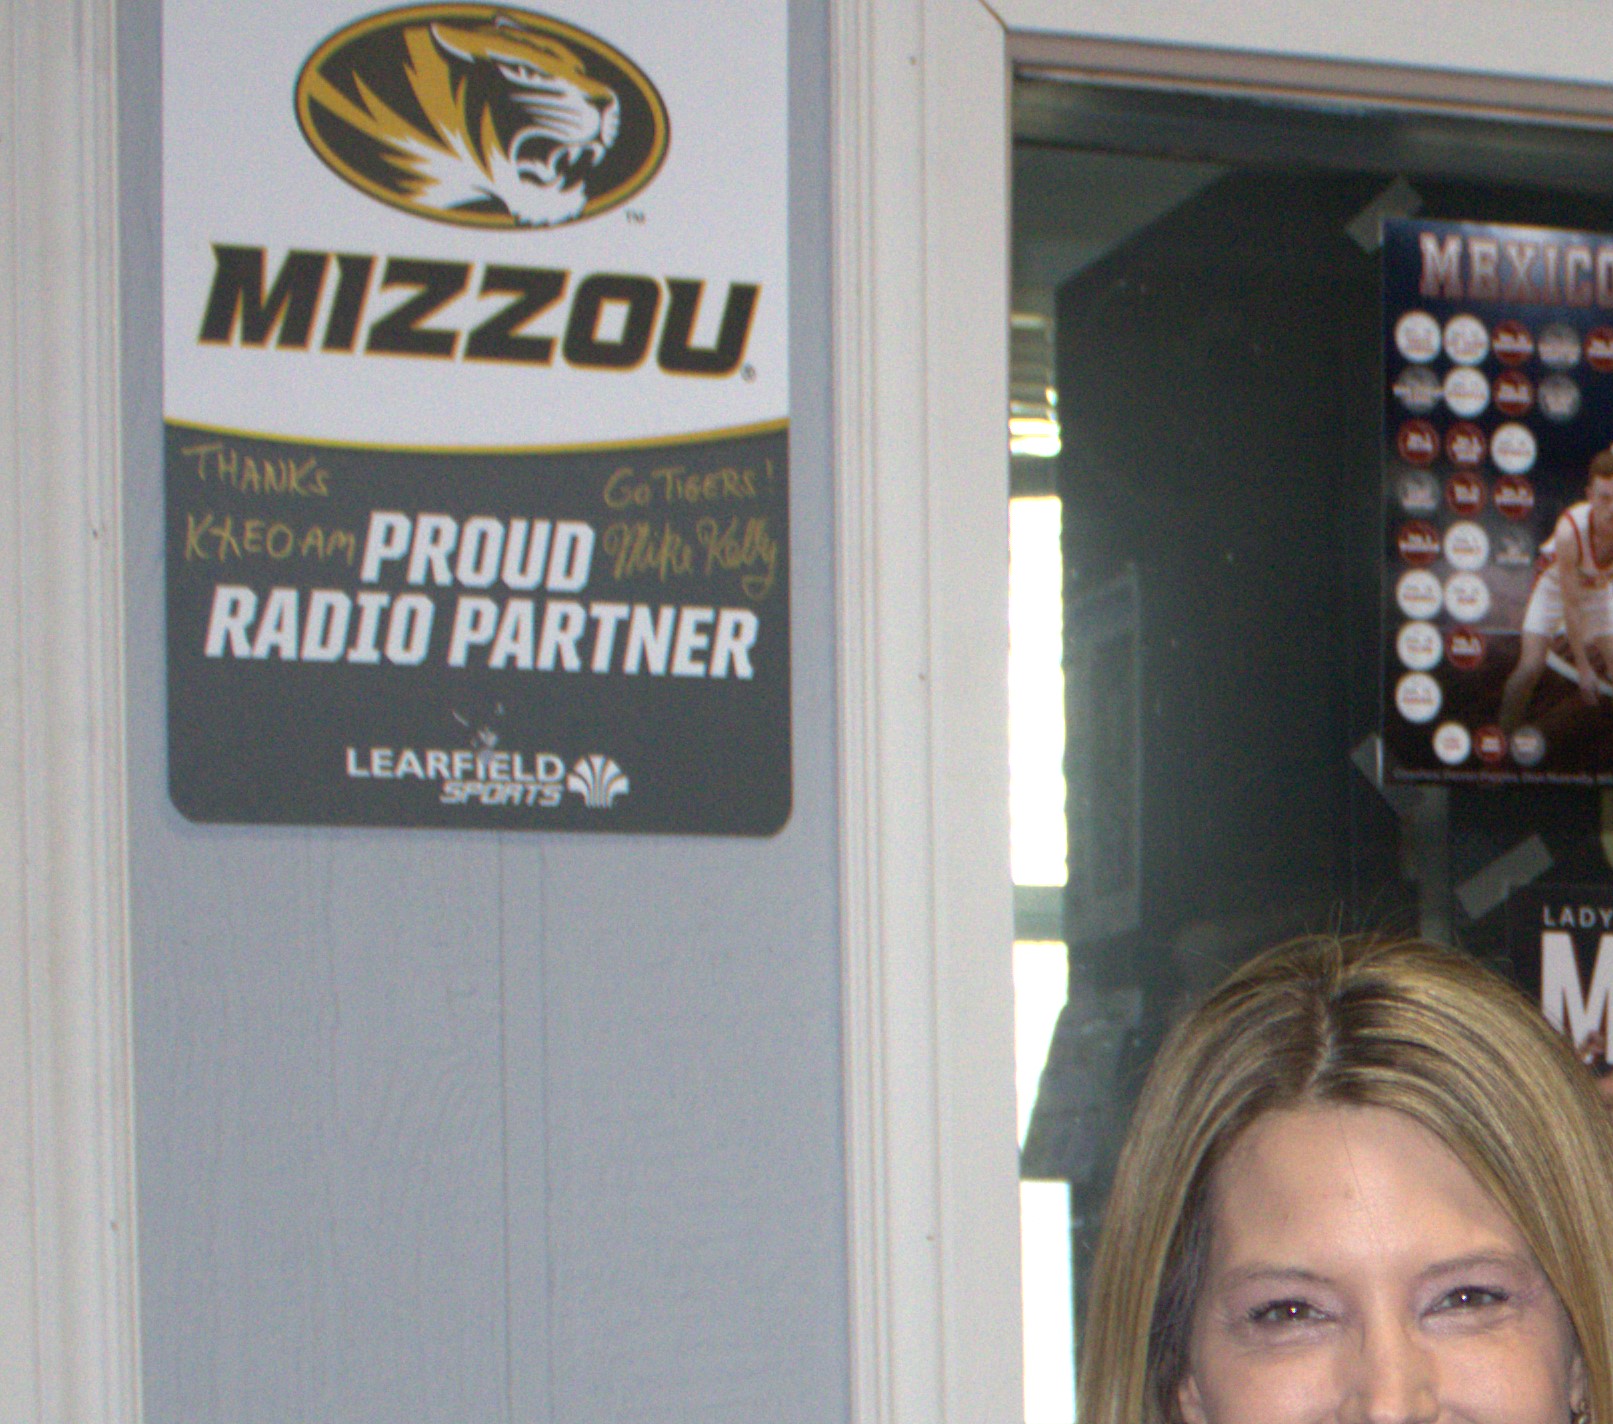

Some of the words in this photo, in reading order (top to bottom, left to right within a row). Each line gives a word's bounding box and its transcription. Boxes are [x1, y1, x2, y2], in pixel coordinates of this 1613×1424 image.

[197, 242, 762, 380] MIZZOU
[181, 441, 331, 498] THANKS
[360, 509, 596, 593] PROUD
[204, 584, 436, 667] RADIO
[447, 595, 760, 680] PARTNER
[345, 746, 567, 783] LEARFIELD
[439, 780, 566, 808] SPORTS
[1542, 904, 1613, 930] LADY
